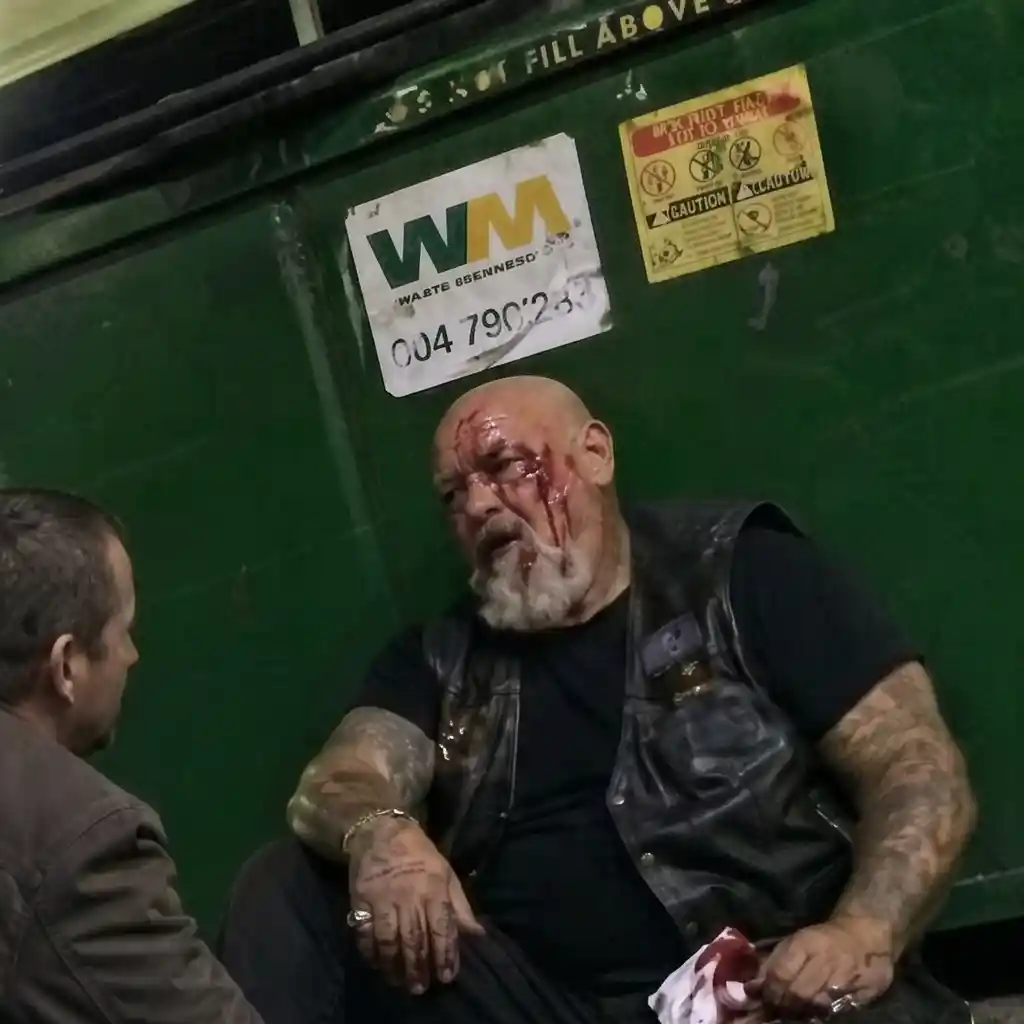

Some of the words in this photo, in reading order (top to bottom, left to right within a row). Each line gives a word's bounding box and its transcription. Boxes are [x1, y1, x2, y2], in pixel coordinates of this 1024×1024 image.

[525, 34, 583, 74] FILL
[596, 0, 710, 49] ABOVE
[366, 175, 572, 290] WM
[670, 190, 726, 219] CAUTION
[391, 324, 454, 368] 004
